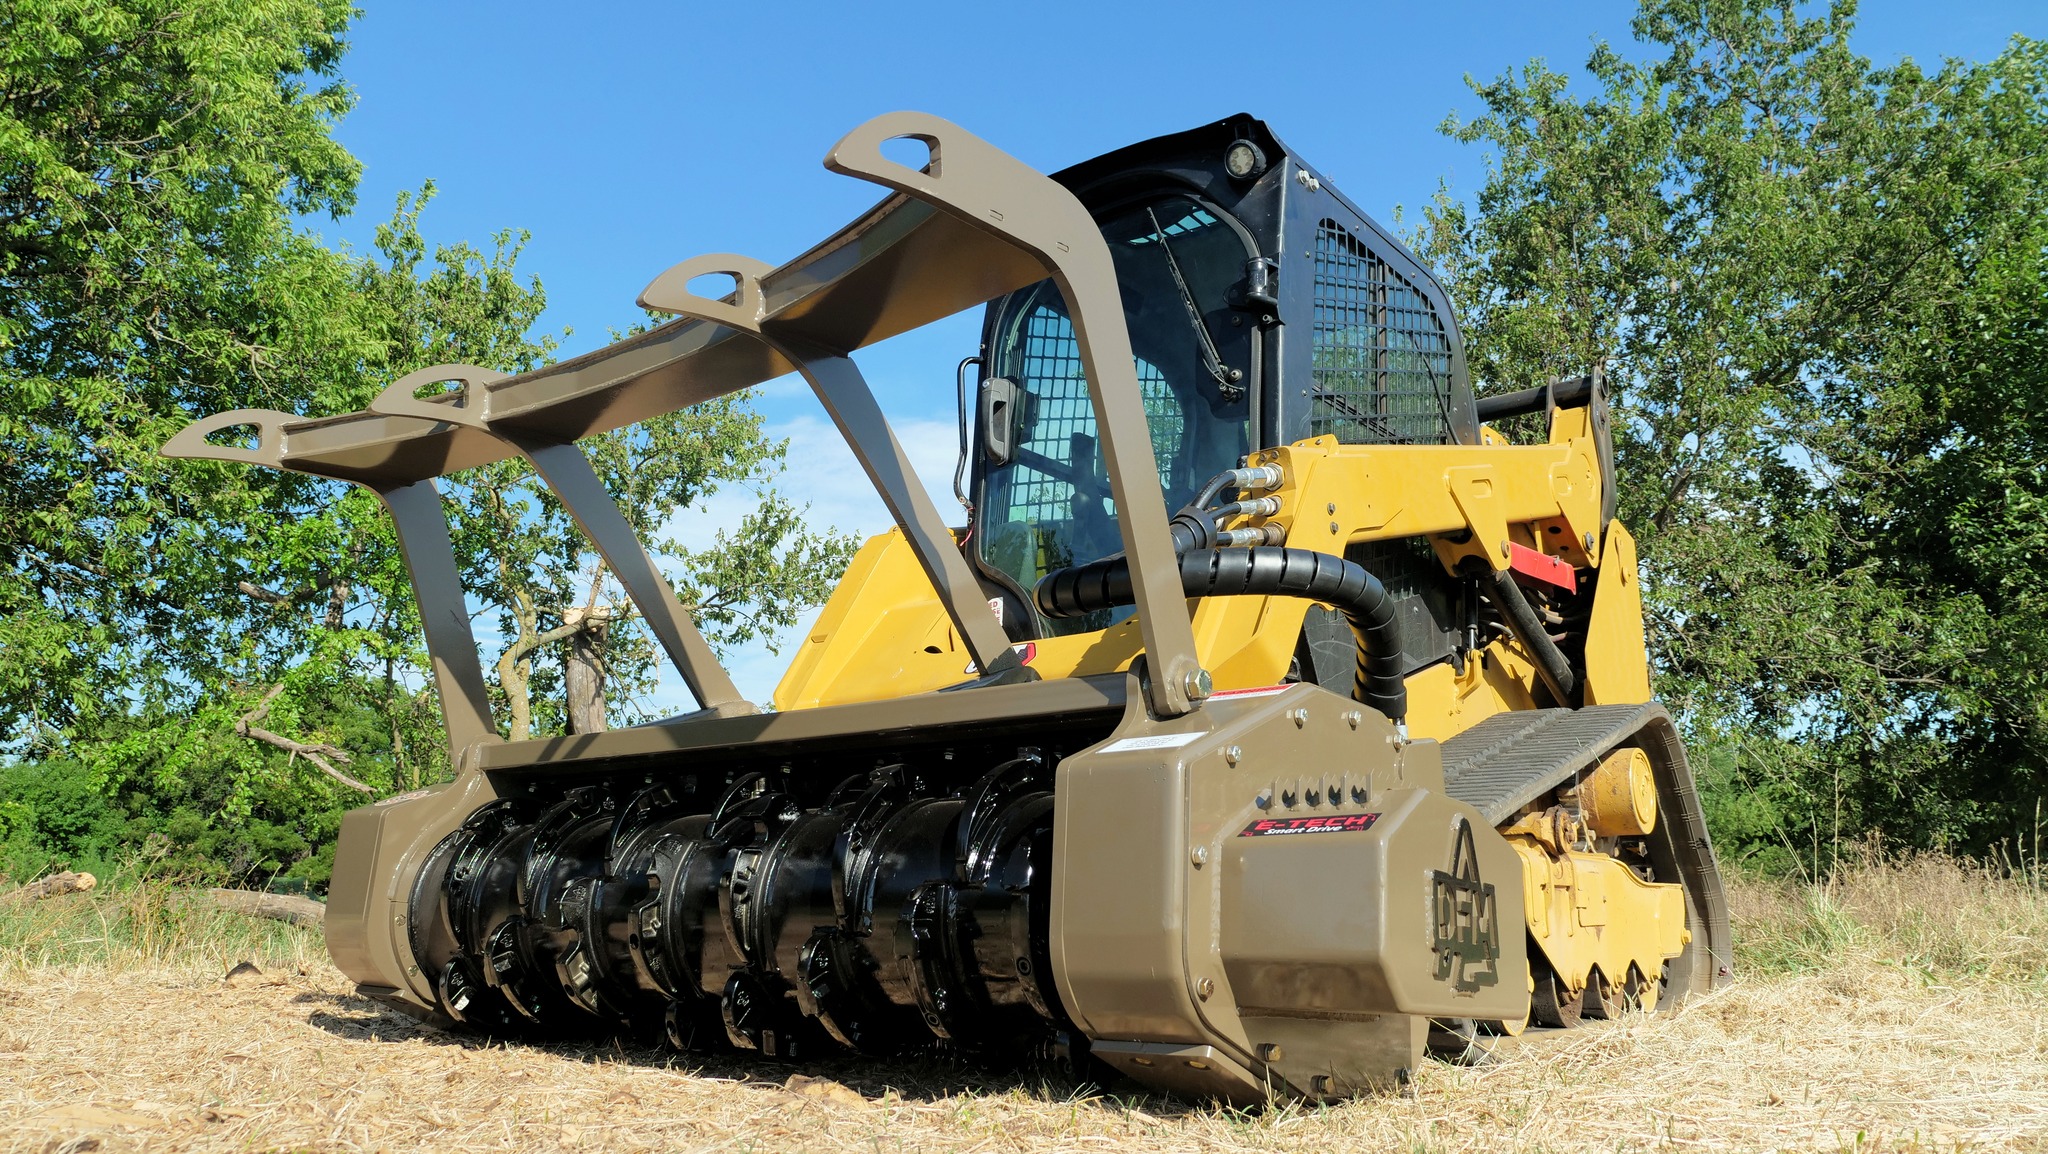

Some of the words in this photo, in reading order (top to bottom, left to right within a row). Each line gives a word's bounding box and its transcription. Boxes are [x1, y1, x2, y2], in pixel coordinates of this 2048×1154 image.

[1254, 816, 1368, 831] E-TECH
[1264, 826, 1306, 836] Smart
[1306, 825, 1342, 833] Drive
